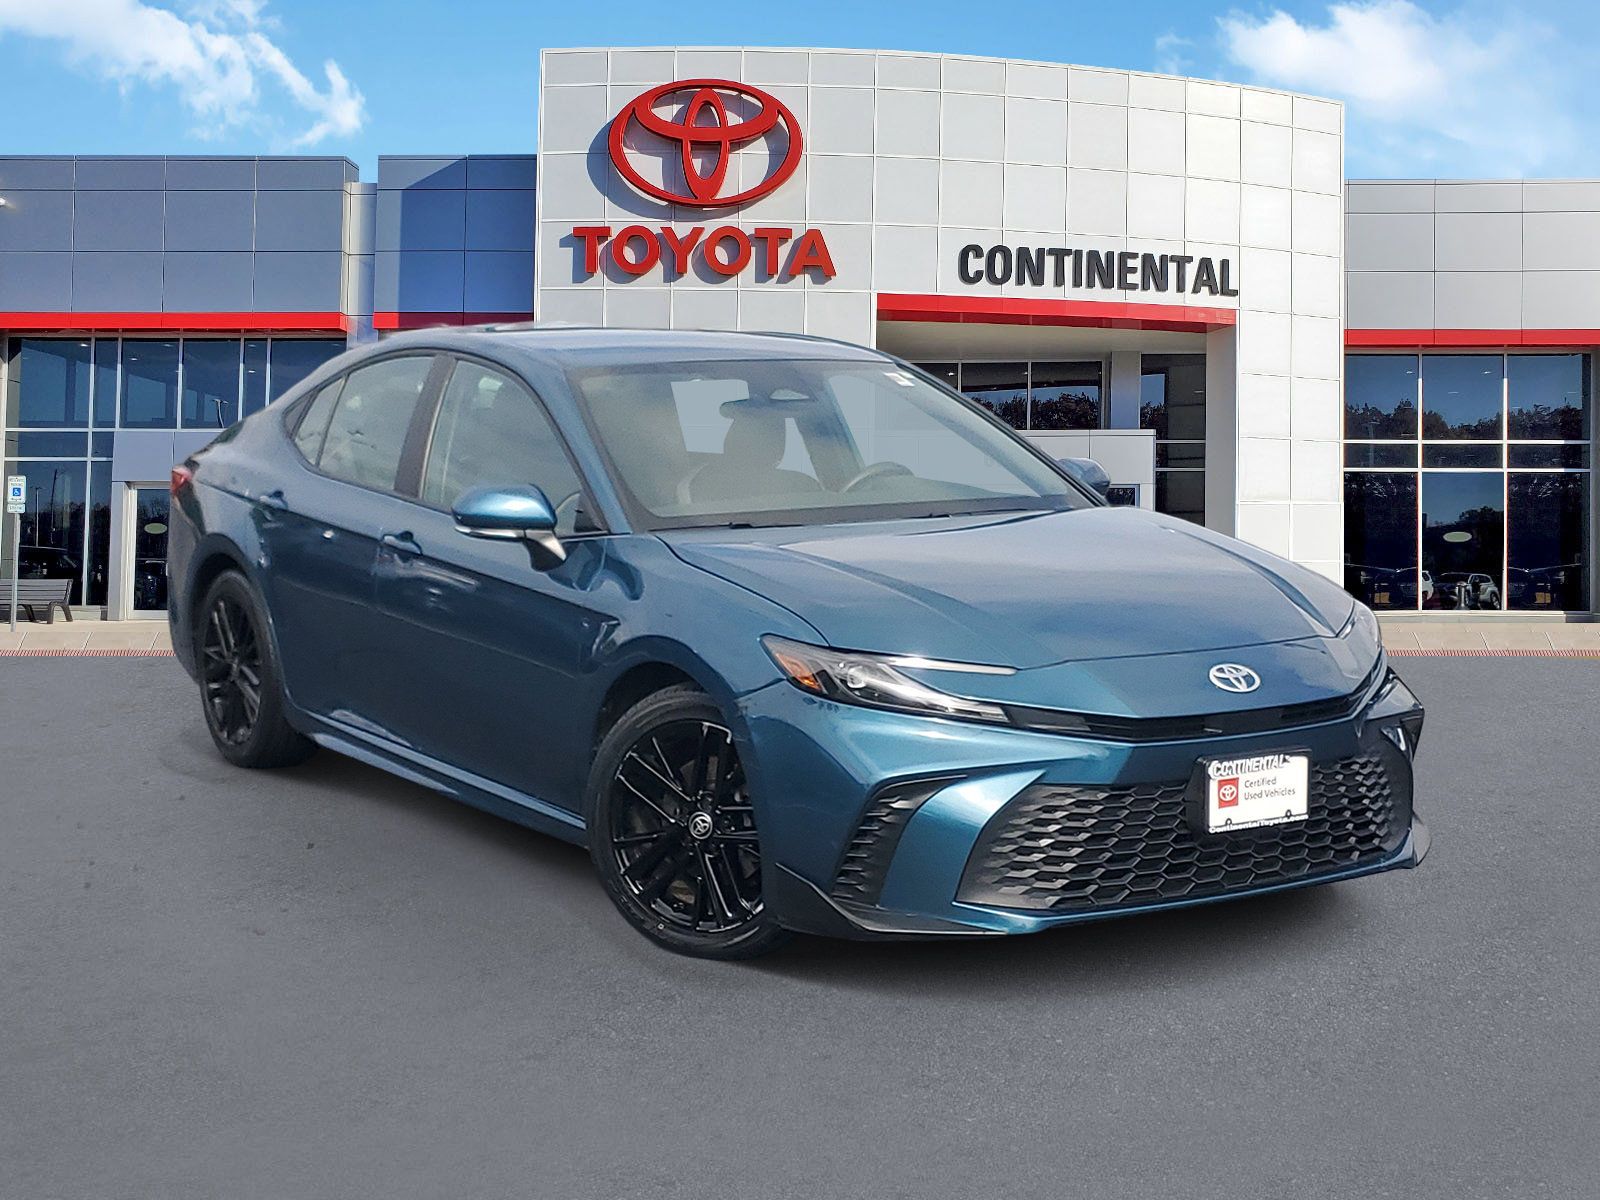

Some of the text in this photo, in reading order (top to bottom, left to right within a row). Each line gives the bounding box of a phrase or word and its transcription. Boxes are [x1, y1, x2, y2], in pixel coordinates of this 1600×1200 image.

[572, 225, 836, 277] TOYOTA
[958, 244, 1238, 296] CONTINENTAL
[1210, 754, 1287, 778] CONTINENTAL
[1244, 777, 1277, 788] Certified
[1244, 787, 1296, 800] Used Vehicles
